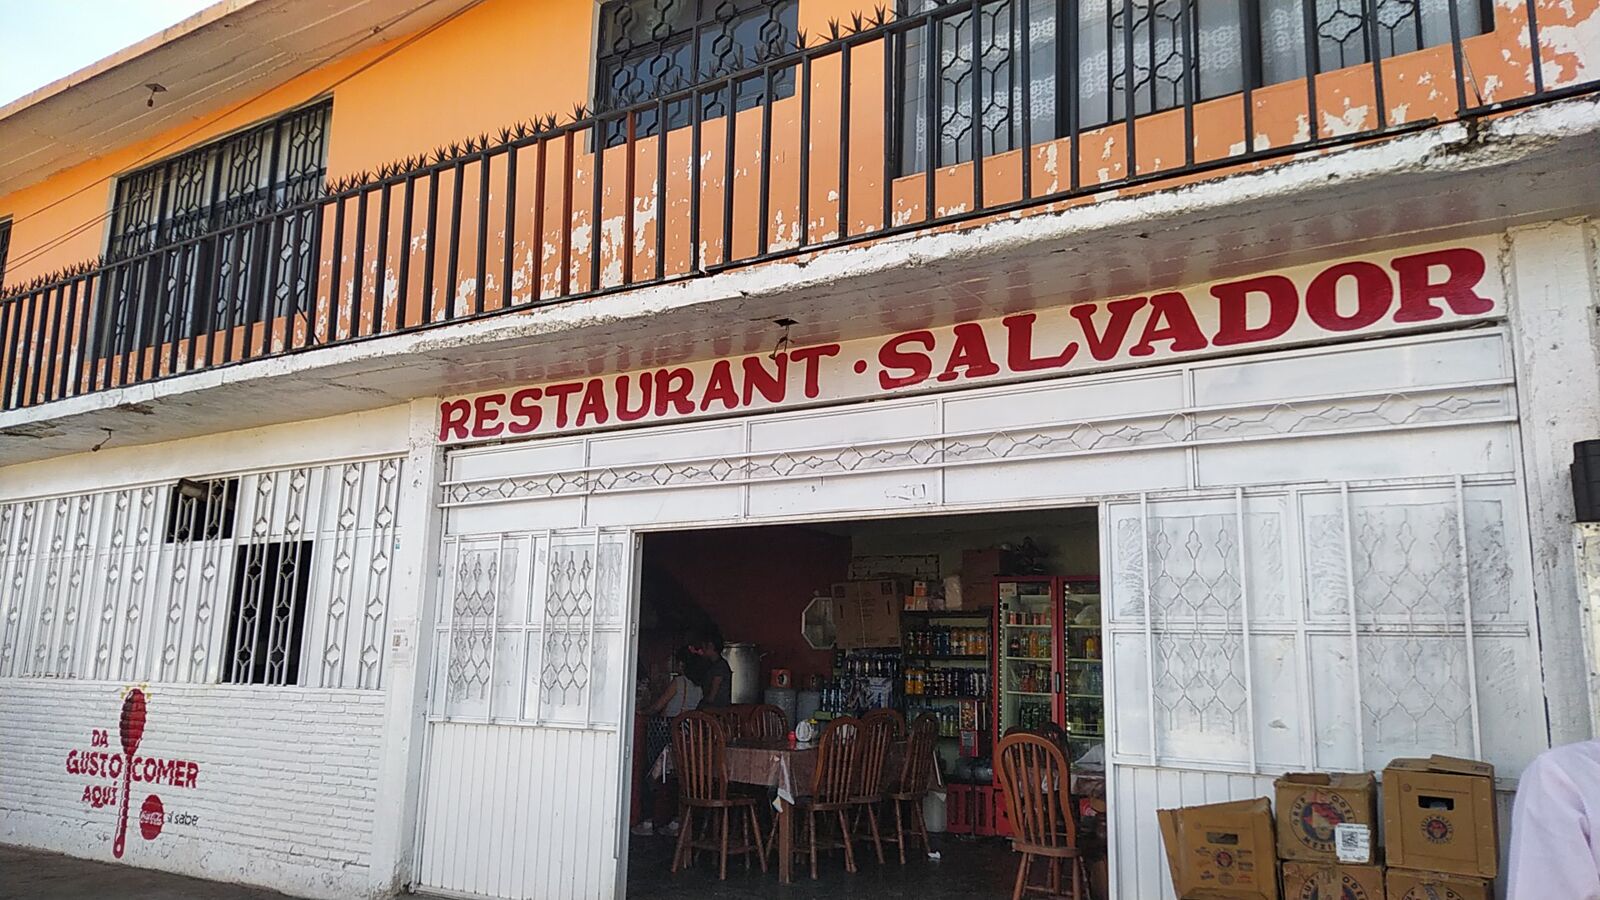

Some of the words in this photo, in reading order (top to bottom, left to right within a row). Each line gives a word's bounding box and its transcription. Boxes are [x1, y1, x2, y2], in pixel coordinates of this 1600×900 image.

[439, 343, 841, 442] RESTAURANT
[878, 247, 1494, 390] SALVADOR
[91, 729, 109, 748] DA
[66, 749, 122, 779] GUSTO
[131, 756, 199, 789] COMER
[82, 781, 118, 808] AQUÍ
[174, 811, 199, 826] sabe
